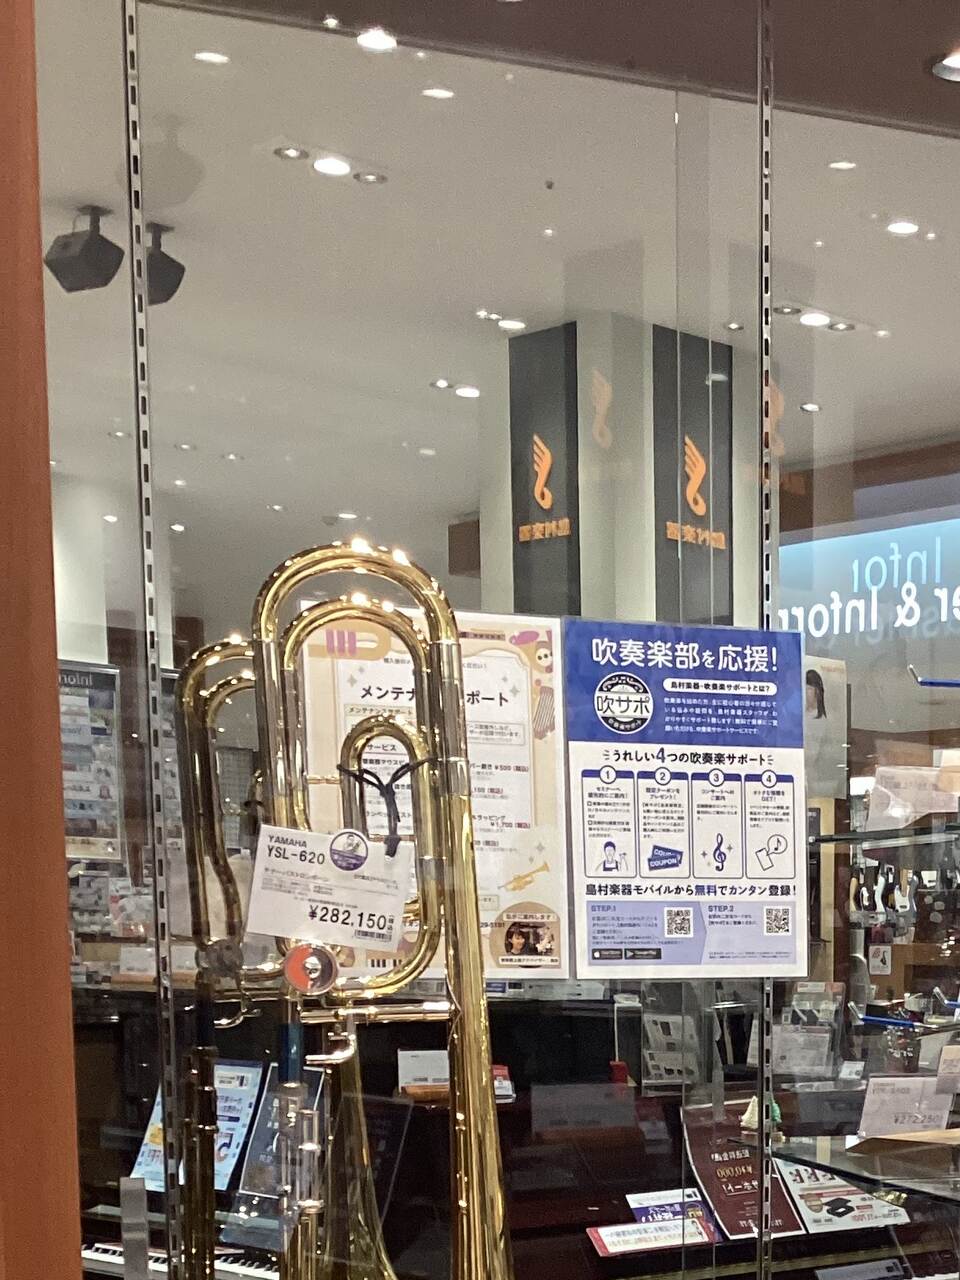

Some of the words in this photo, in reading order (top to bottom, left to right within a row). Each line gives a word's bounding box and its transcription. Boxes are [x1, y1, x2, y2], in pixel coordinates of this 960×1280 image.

[592, 638, 777, 672] 吹奏楽部を応援!
[597, 696, 650, 715] 吹サポ
[614, 747, 765, 766] うれしい4つの吹奏楽サポート
[659, 772, 666, 780] 2
[713, 774, 720, 782] 3
[765, 775, 772, 783] 4
[268, 834, 307, 848] YAMAHA
[267, 845, 325, 865] YSL-620
[586, 884, 797, 897] 島村楽器モバイルから無料でカンタン登録!
